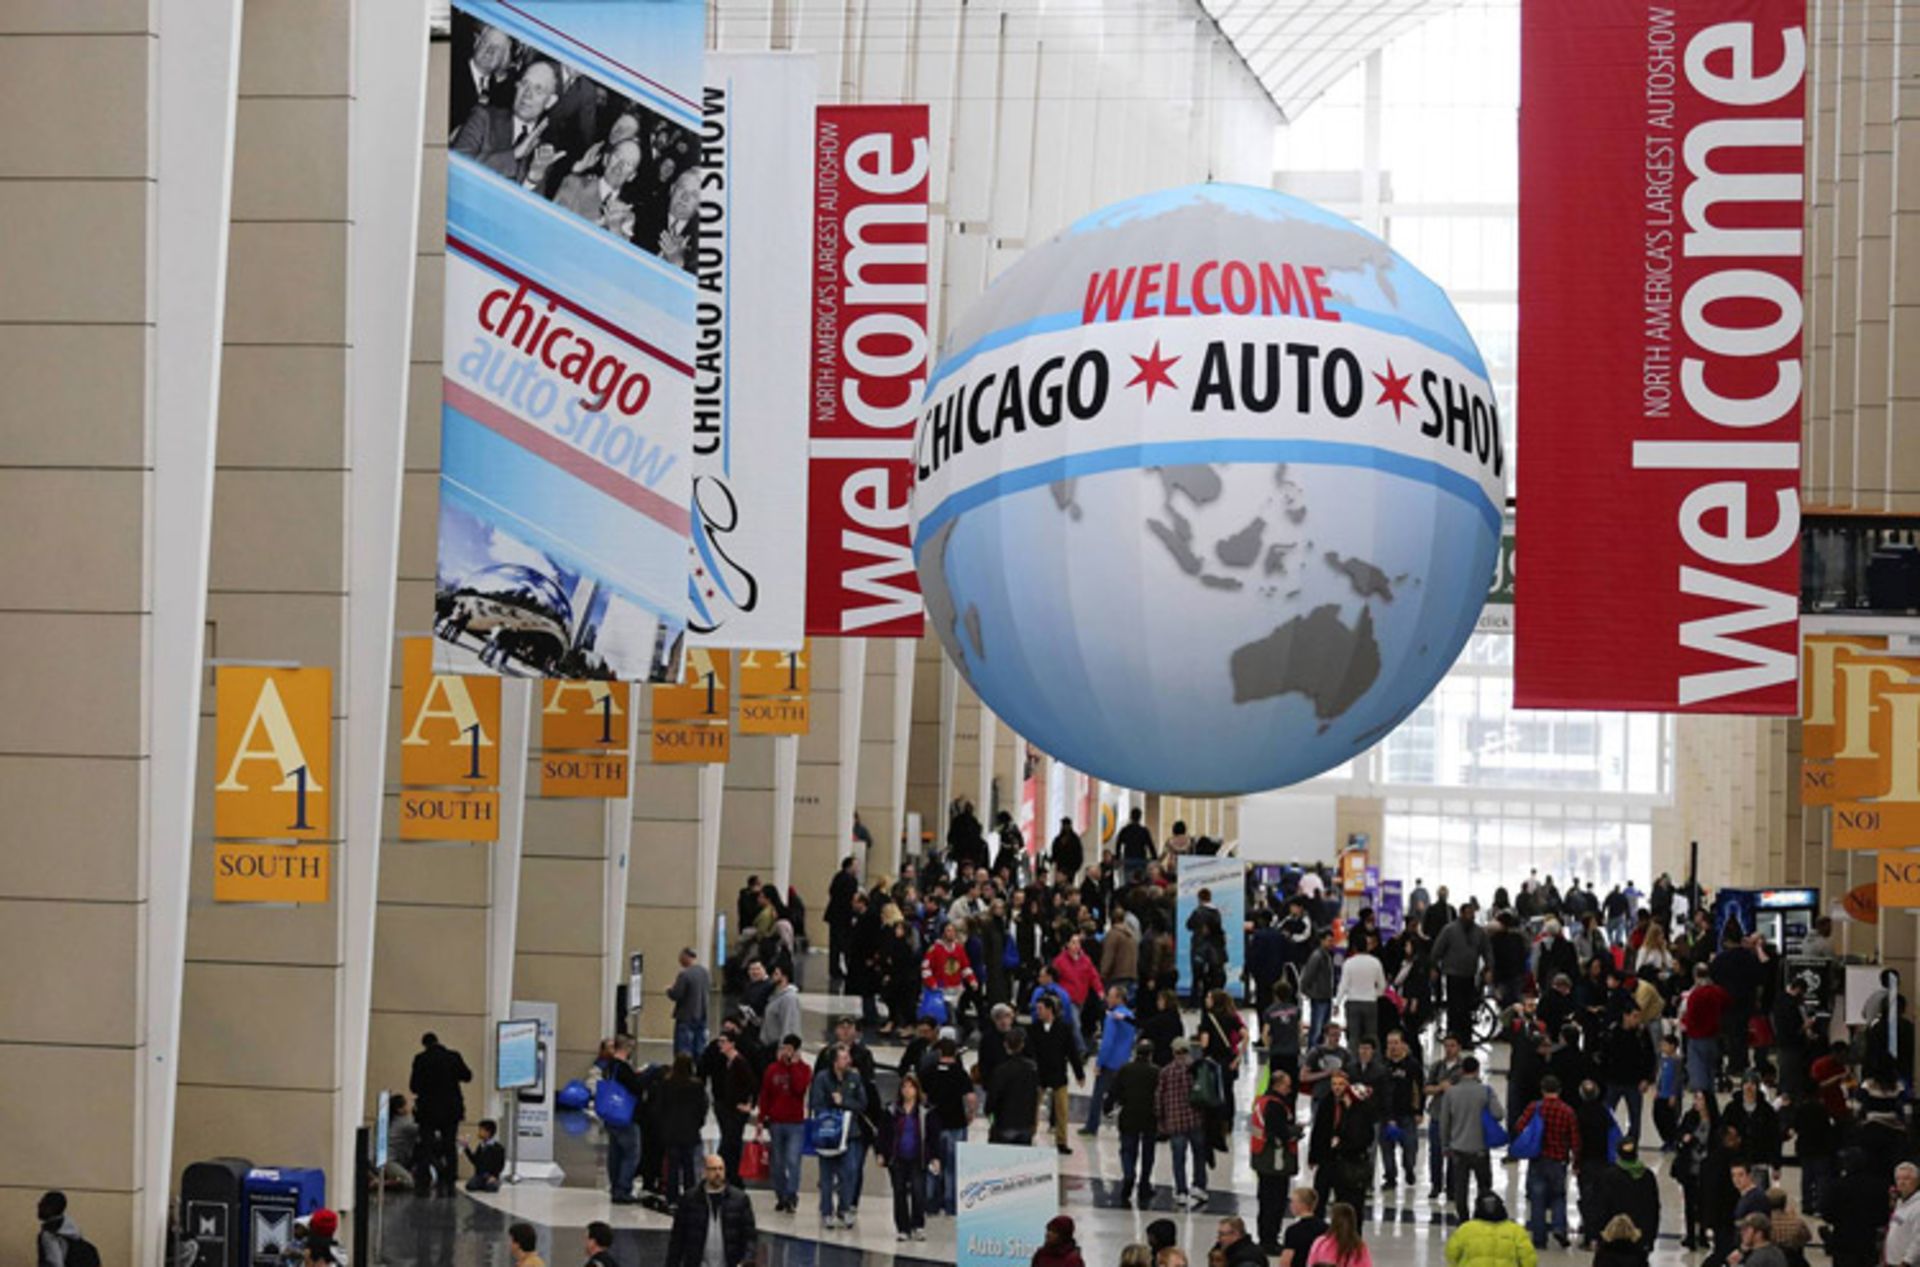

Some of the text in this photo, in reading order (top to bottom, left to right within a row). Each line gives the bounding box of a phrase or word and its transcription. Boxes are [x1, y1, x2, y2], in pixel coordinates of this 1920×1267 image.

[1643, 6, 1676, 418] NORTH AMERICA'S LARGEST AUTOSHOW
[693, 86, 726, 455] CHICAGO AUTO SHOW
[815, 121, 839, 422] NORTH AMERICA'S LARGEST AUTOSHOW
[1081, 260, 1342, 326] WELCOME
[458, 336, 560, 419] auto
[478, 277, 651, 416] chicago
[809, 132, 930, 632] welcome
[1632, 21, 1806, 706] welcome
[918, 349, 1110, 482] CHICAGO
[1191, 340, 1363, 418] AUTO
[656, 729, 725, 748] SOUTH
[743, 706, 805, 721] SOUTH
[405, 798, 492, 821] SOUTH
[545, 761, 622, 780] SOUTH
[218, 853, 321, 879] SOUTH
